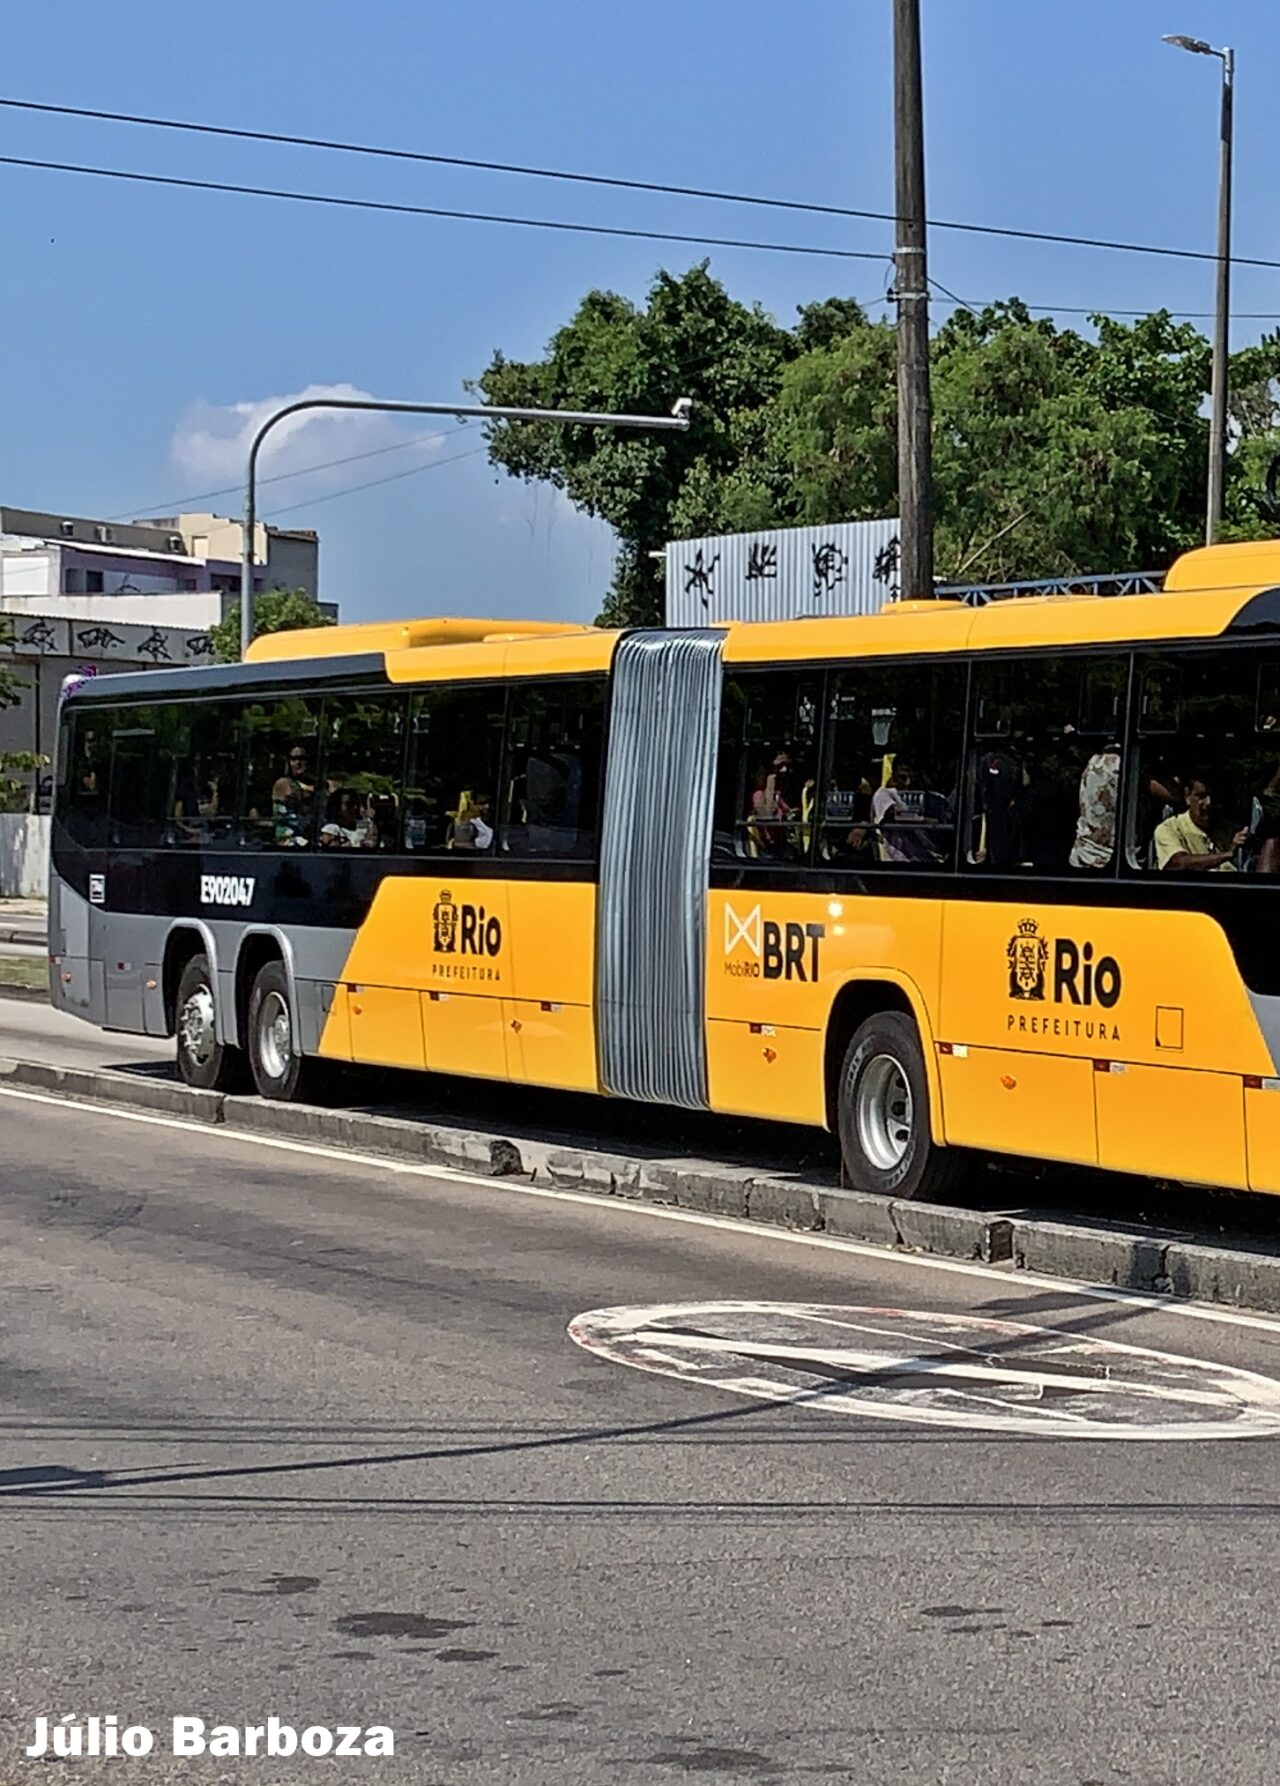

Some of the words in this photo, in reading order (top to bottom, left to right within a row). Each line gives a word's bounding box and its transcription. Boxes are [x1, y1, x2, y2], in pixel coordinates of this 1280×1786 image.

[200, 874, 255, 906] E902047
[461, 904, 501, 957] Rio
[763, 921, 825, 982] BRT
[432, 964, 500, 981] PREFEITURA
[1054, 938, 1121, 1008] Rio
[1007, 1014, 1120, 1041] PREFEITURA
